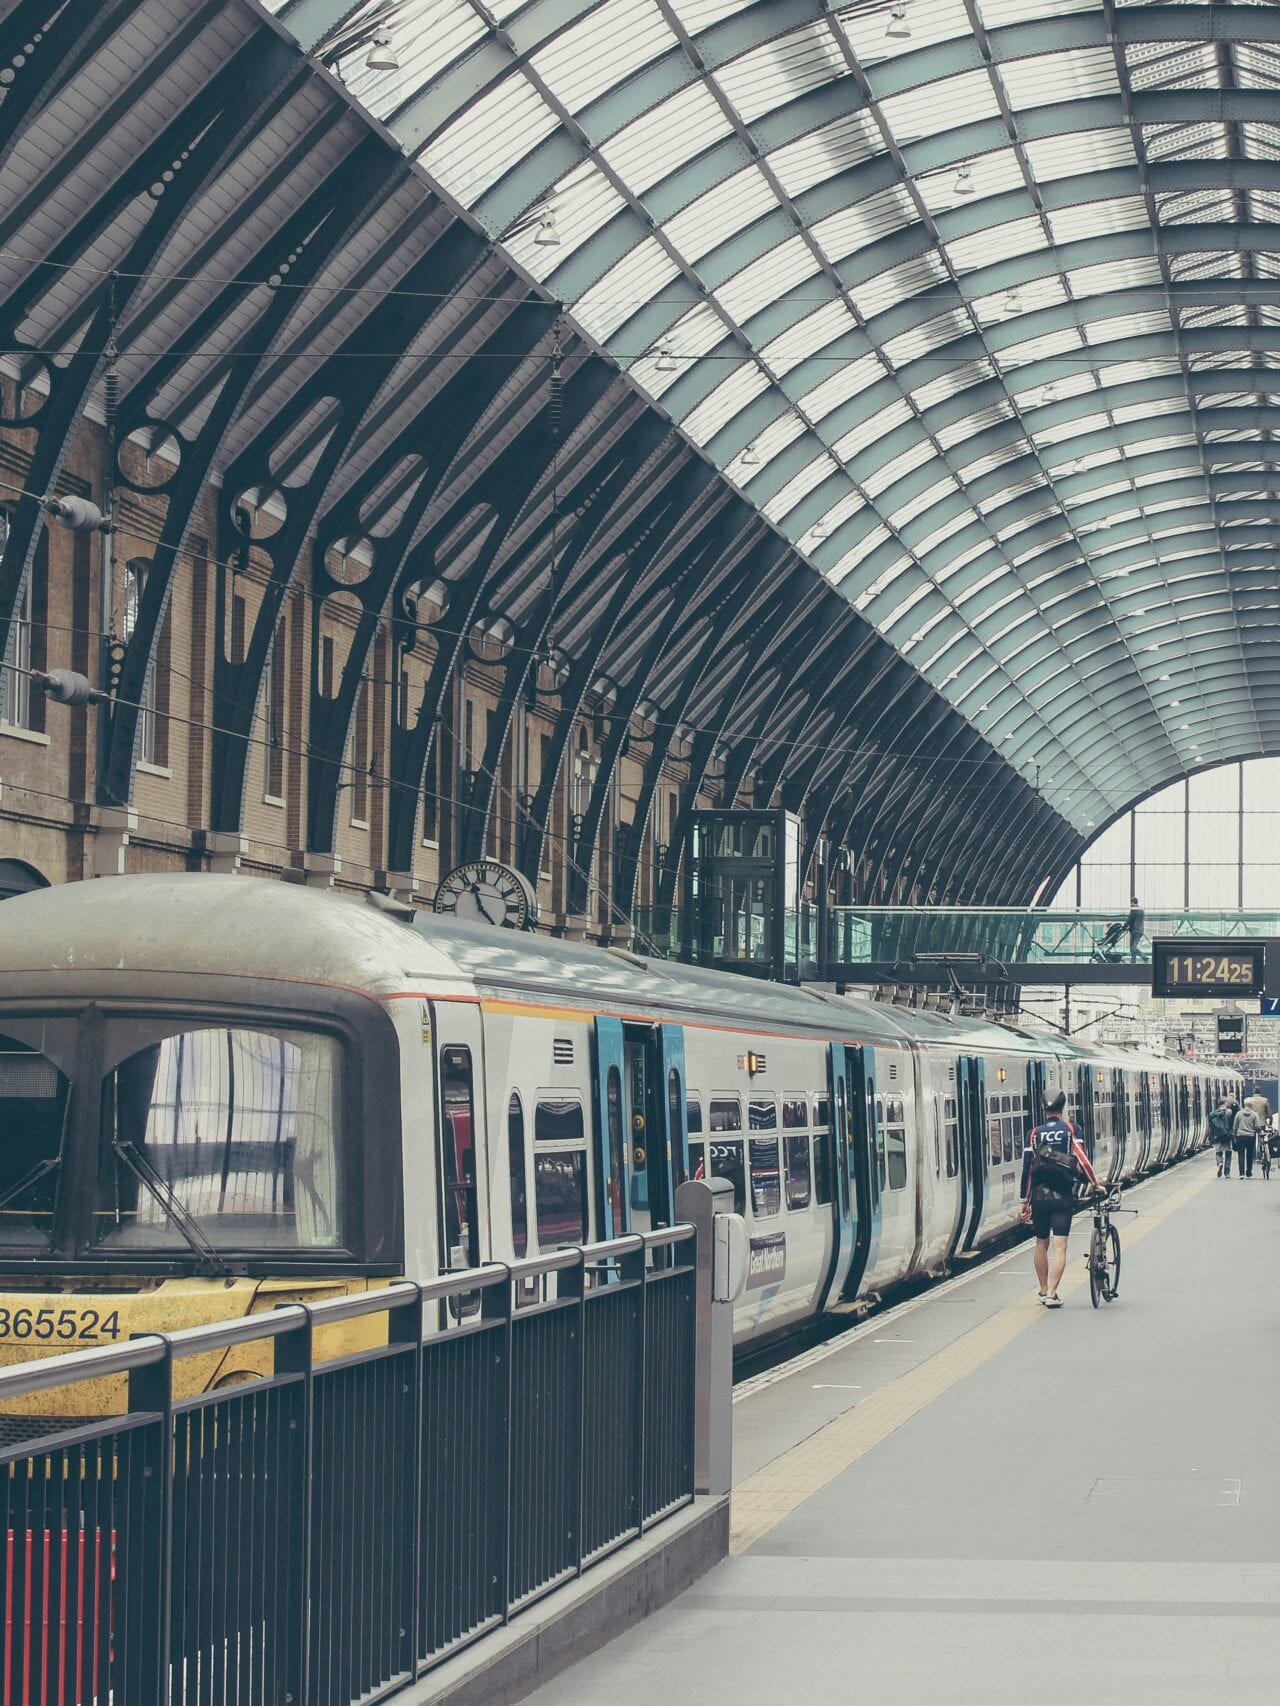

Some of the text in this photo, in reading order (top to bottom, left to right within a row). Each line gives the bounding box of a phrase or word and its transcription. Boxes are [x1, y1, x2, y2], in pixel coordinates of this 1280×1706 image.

[1169, 957, 1253, 983] 11:24 25
[1268, 998, 1279, 1011] 7
[1040, 1130, 1064, 1142] TCC
